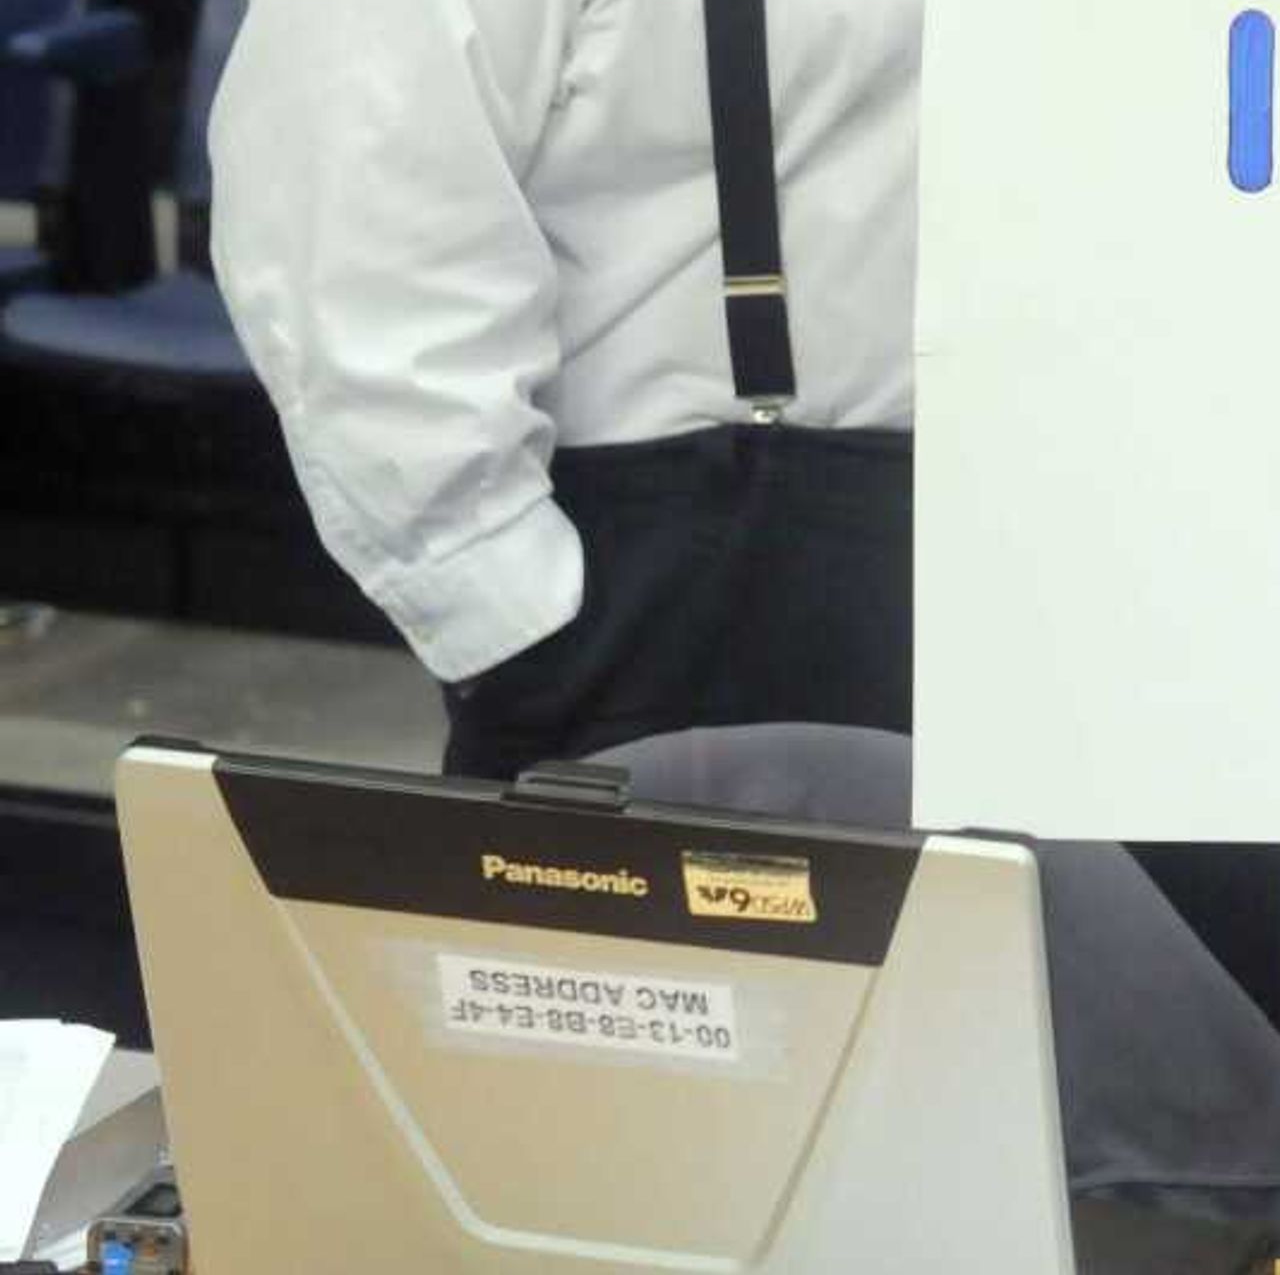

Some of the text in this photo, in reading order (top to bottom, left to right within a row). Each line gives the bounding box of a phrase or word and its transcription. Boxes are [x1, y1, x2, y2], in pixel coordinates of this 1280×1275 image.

[480, 854, 649, 898] Panasonic
[468, 969, 710, 1015] MAC ADDRESS
